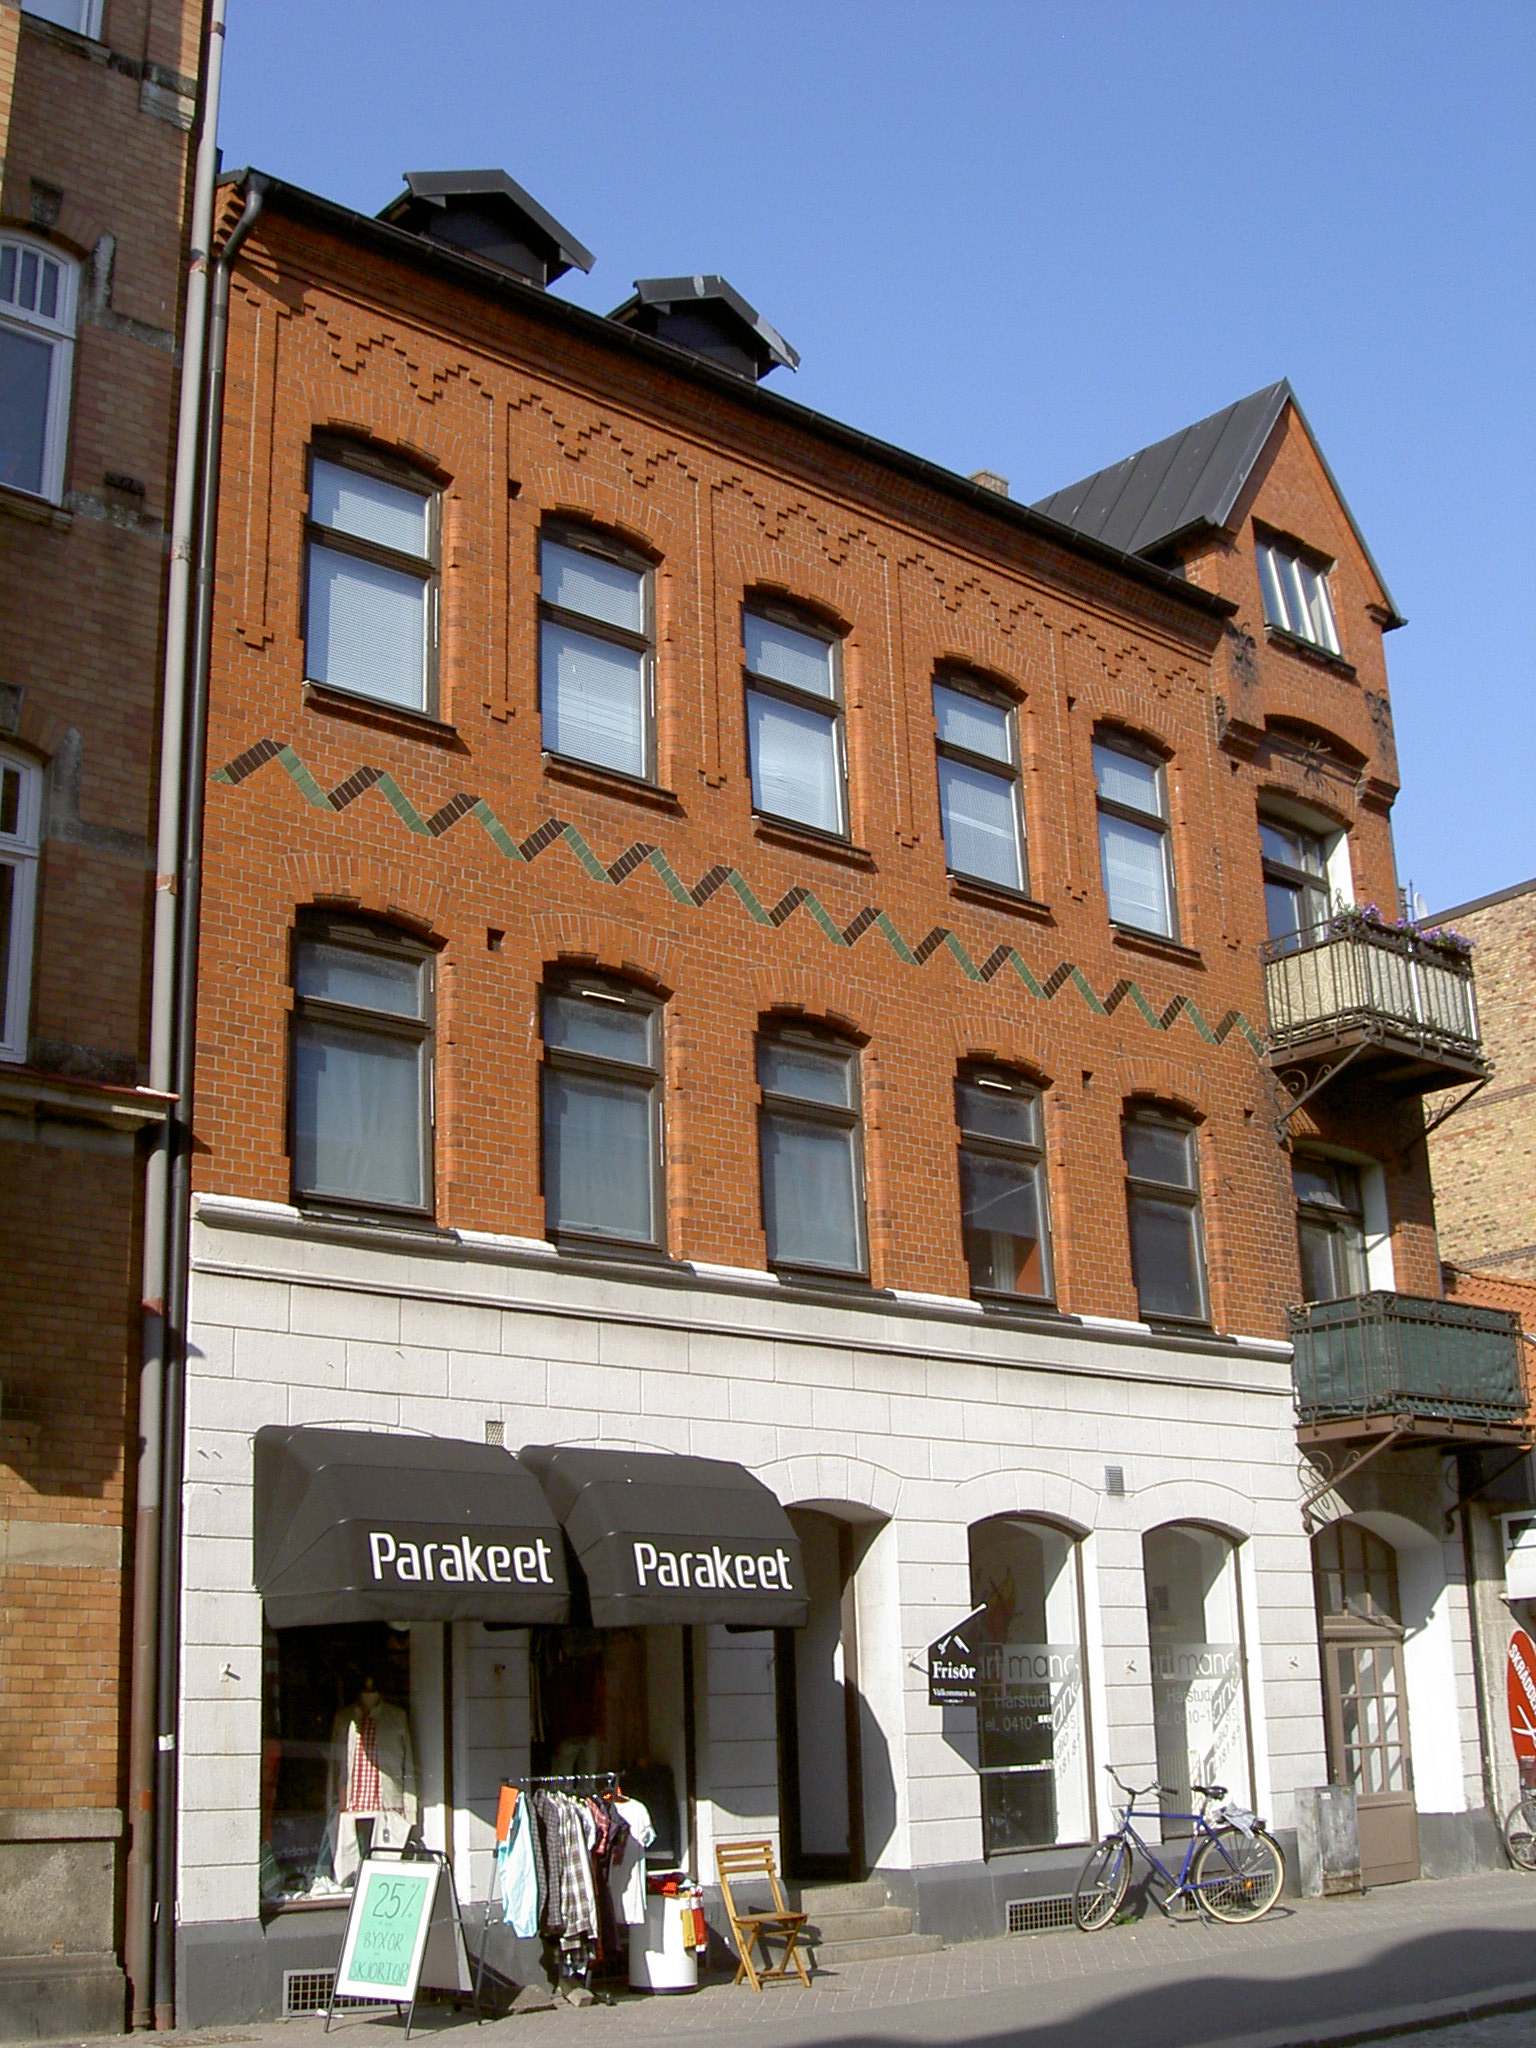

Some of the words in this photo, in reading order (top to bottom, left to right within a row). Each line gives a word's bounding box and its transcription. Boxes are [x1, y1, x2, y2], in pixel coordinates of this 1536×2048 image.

[369, 1531, 554, 1584] Parakeet
[633, 1542, 793, 1590] Parakeet
[932, 1660, 977, 1680] Frisör
[1508, 1643, 1536, 1715] SKRÄDDE
[372, 1881, 421, 1919] 25%
[363, 1931, 404, 1952] BYXOR
